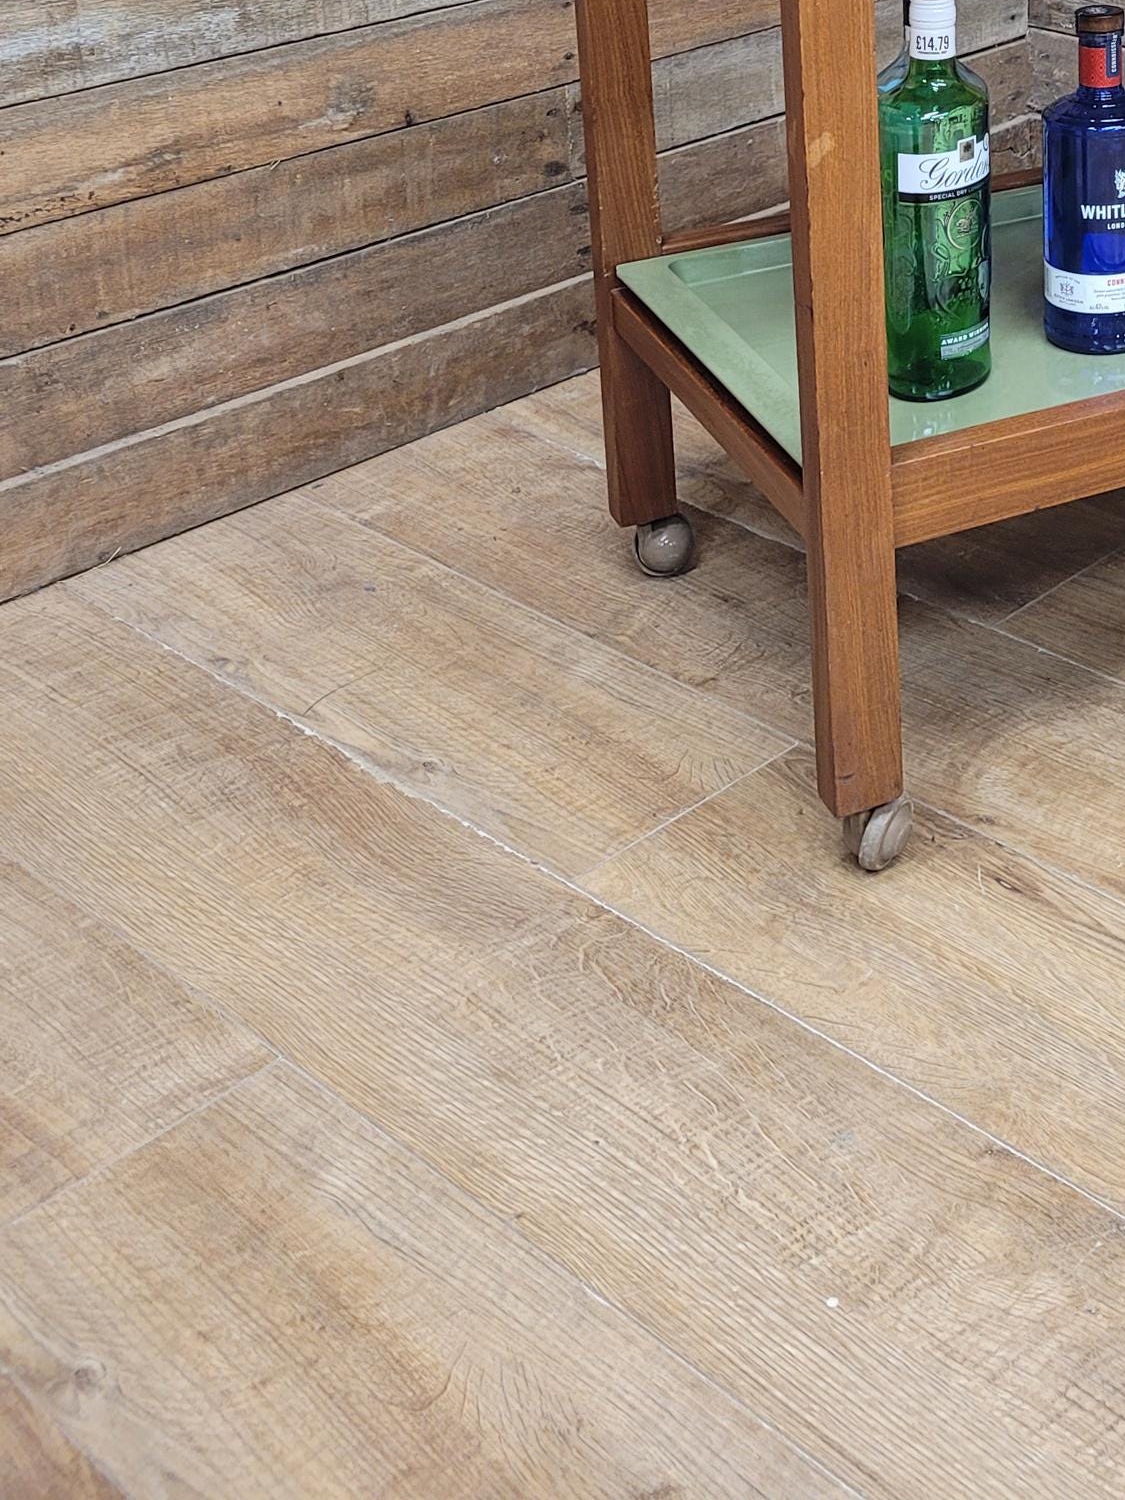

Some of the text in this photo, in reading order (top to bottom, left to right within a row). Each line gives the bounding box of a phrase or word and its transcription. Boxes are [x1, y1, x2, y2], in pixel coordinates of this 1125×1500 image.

[916, 35, 950, 51] £14.79
[929, 192, 955, 201] SPECIAL
[941, 334, 968, 346] AWARD
